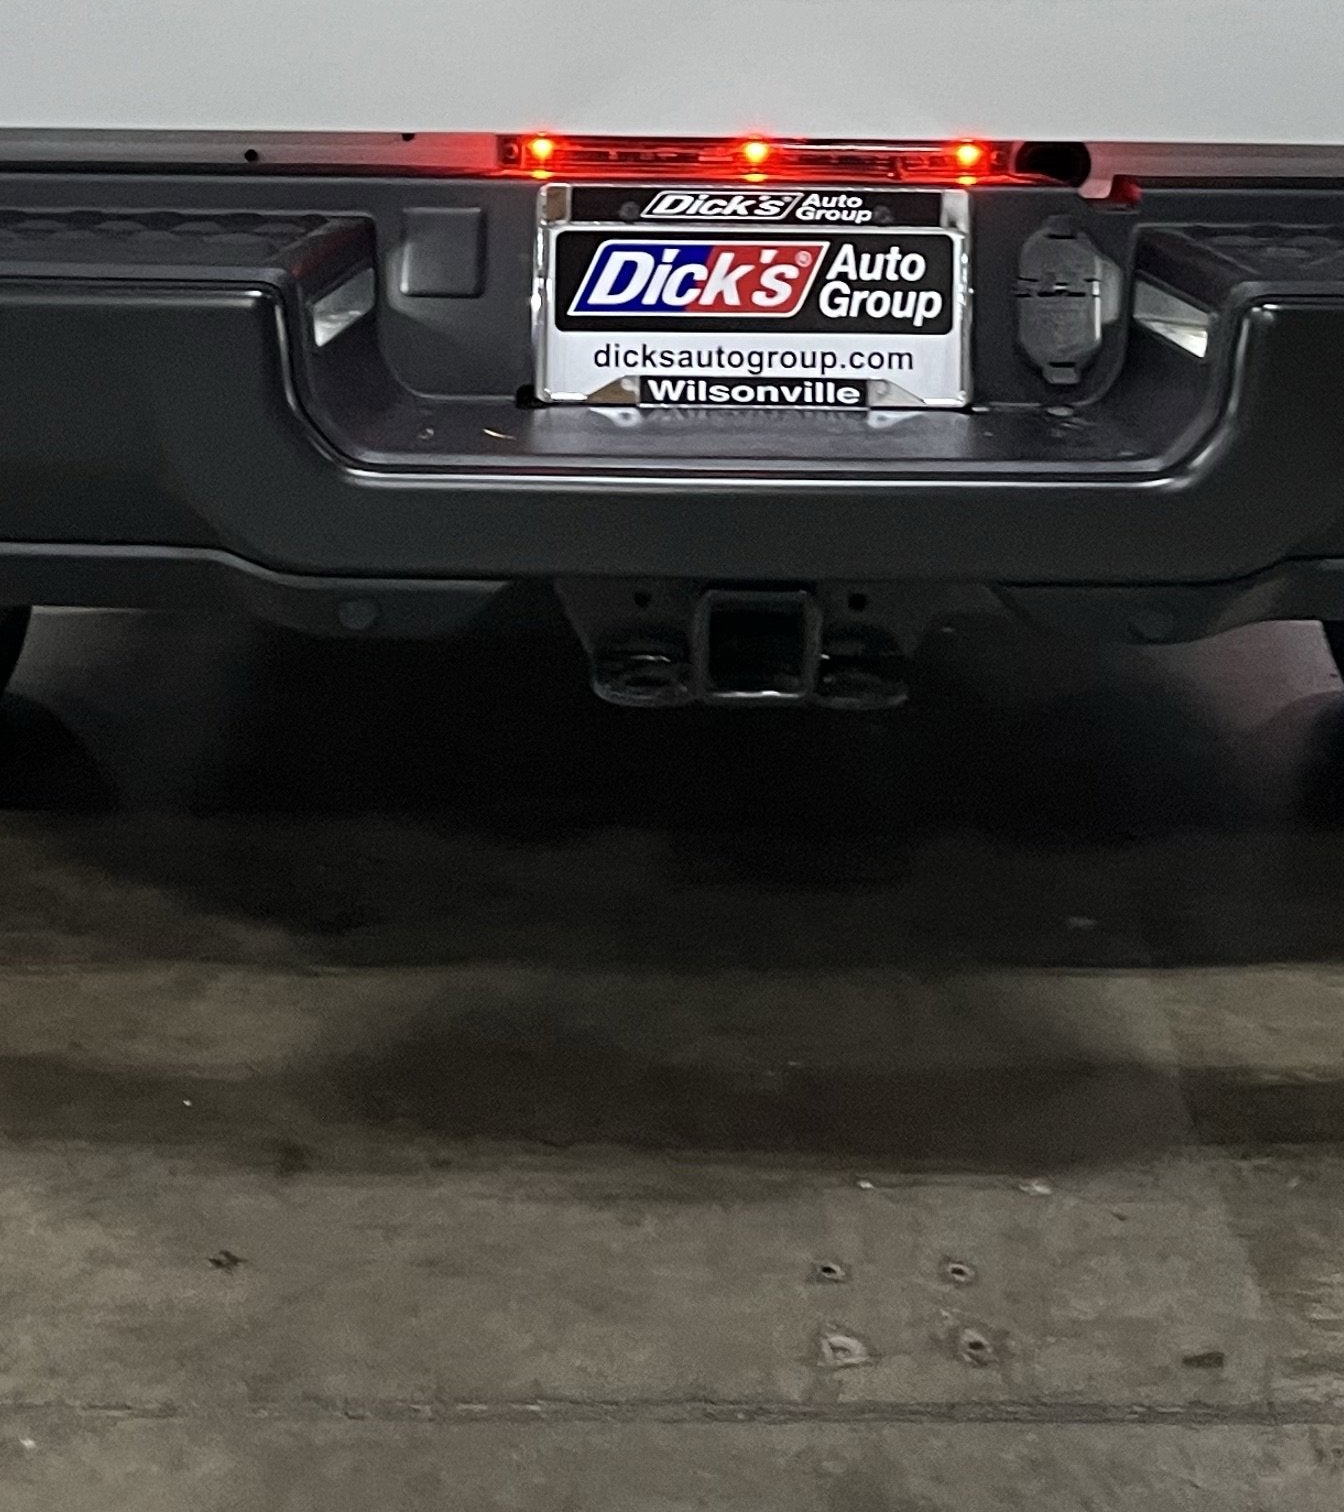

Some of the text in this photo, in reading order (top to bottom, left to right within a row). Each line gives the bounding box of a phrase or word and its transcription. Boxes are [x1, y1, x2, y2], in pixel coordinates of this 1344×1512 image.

[652, 193, 788, 216] Dick's
[801, 193, 863, 208] Auto
[795, 207, 872, 224] Group
[826, 243, 926, 282] Auto
[586, 248, 801, 308] Dick's
[819, 281, 943, 327] Group
[593, 343, 914, 374] dicksautogroup.com
[647, 379, 861, 405] Wilsonville
